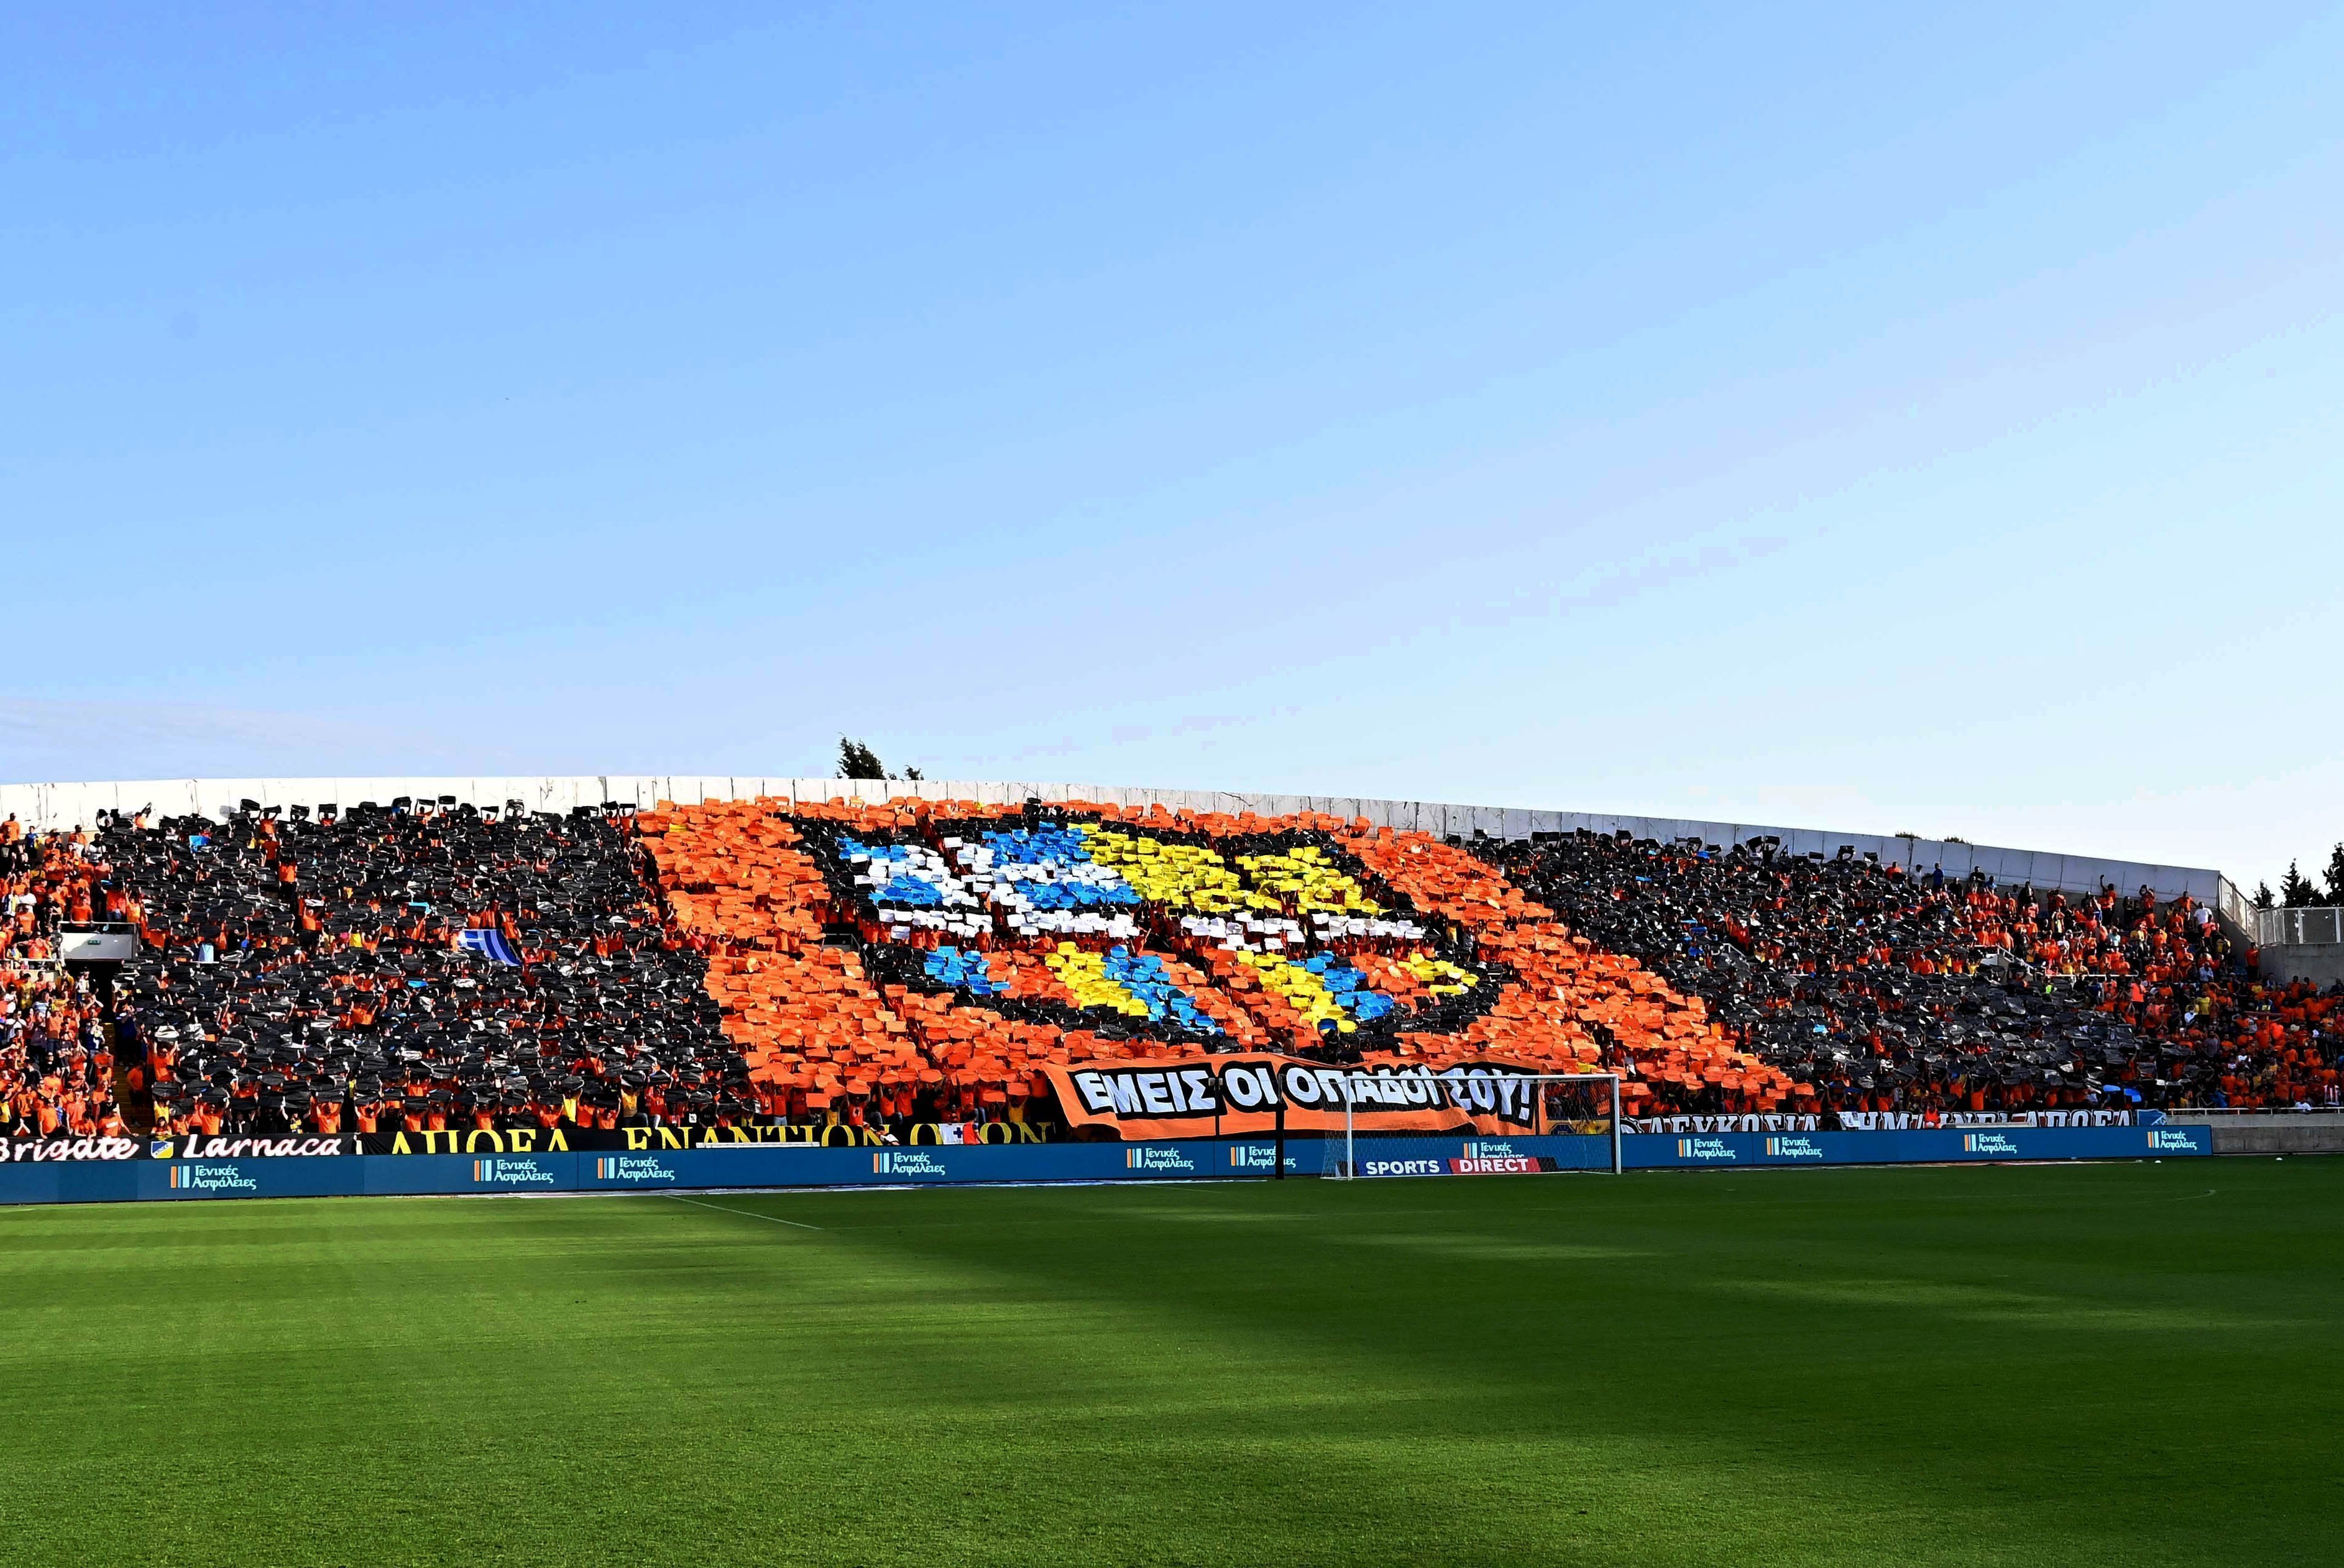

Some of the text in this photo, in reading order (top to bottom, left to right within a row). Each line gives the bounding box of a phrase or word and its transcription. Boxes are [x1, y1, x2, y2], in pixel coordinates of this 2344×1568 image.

[1075, 1070, 1216, 1113] ΕΜΕΙΣ
[1225, 1068, 1278, 1106] ΟΙ
[183, 1134, 342, 1158] Larnaca
[1481, 1142, 1512, 1154] Γενικές
[1694, 1139, 1723, 1149] Γενικές
[1781, 1137, 1810, 1148] Γενικές
[1145, 1147, 1180, 1160] Γενικές
[1249, 1145, 1276, 1156] Γενικέ
[1693, 1148, 1736, 1160] Ασφάλειες
[1780, 1147, 1822, 1158] Ασφάλειες
[619, 1157, 659, 1170] Γενικές
[893, 1152, 931, 1164] Γενικές
[1143, 1158, 1194, 1171] Ασφάλειες
[1247, 1156, 1296, 1169] Ασφάλιες
[195, 1165, 239, 1178] Γενικές
[497, 1159, 537, 1172] Γενικές
[891, 1163, 945, 1176] Ασφάλειες
[1366, 1158, 1528, 1175] SPORTS DIRECT
[494, 1170, 554, 1185] Ασφάλειες
[617, 1168, 675, 1181] Ασφάλειες
[192, 1176, 257, 1191] Ασφάλειες
